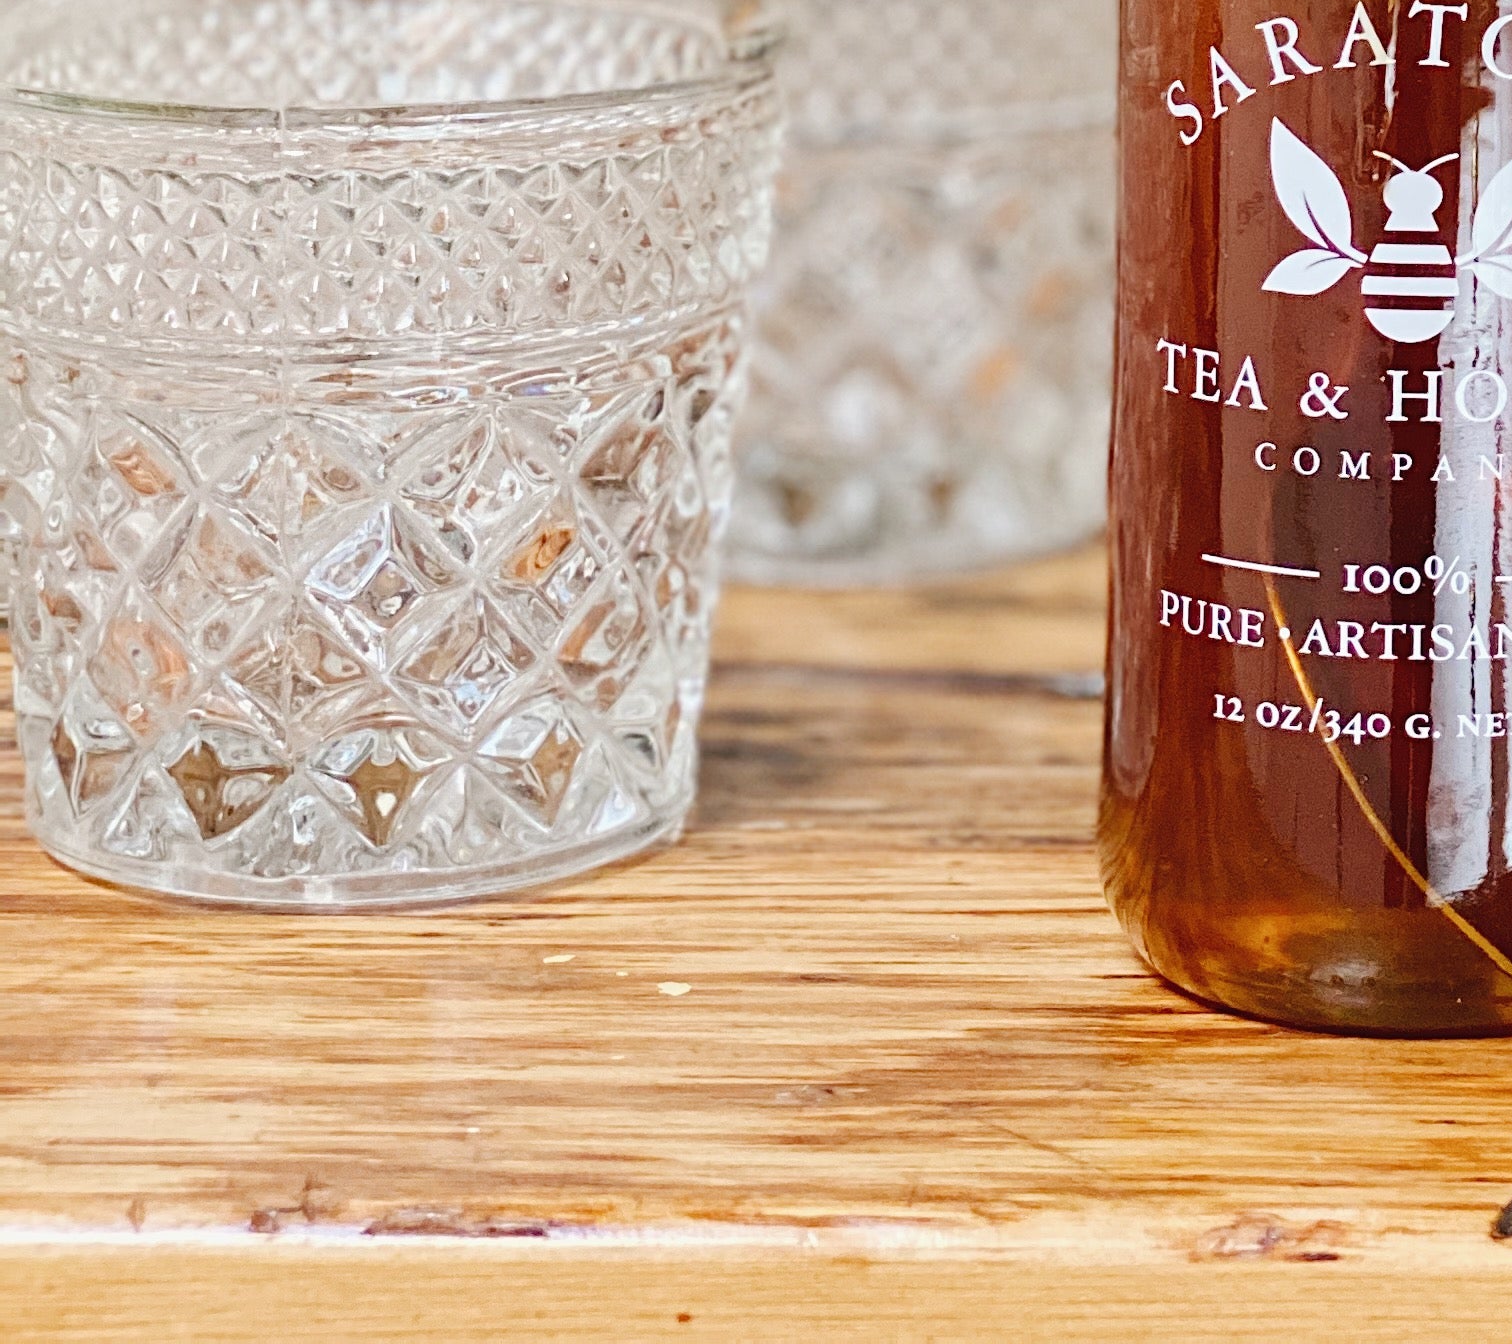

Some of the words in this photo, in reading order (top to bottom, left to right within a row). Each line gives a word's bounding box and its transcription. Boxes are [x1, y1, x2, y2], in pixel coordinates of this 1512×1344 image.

[1156, 337, 1268, 411] TEA
[1299, 372, 1349, 419] &
[1343, 555, 1470, 596] 100%
[1159, 589, 1266, 648] PURE
[1213, 694, 1245, 722] 12
[1256, 698, 1389, 745] OZ/340
[1404, 710, 1441, 739] G.
